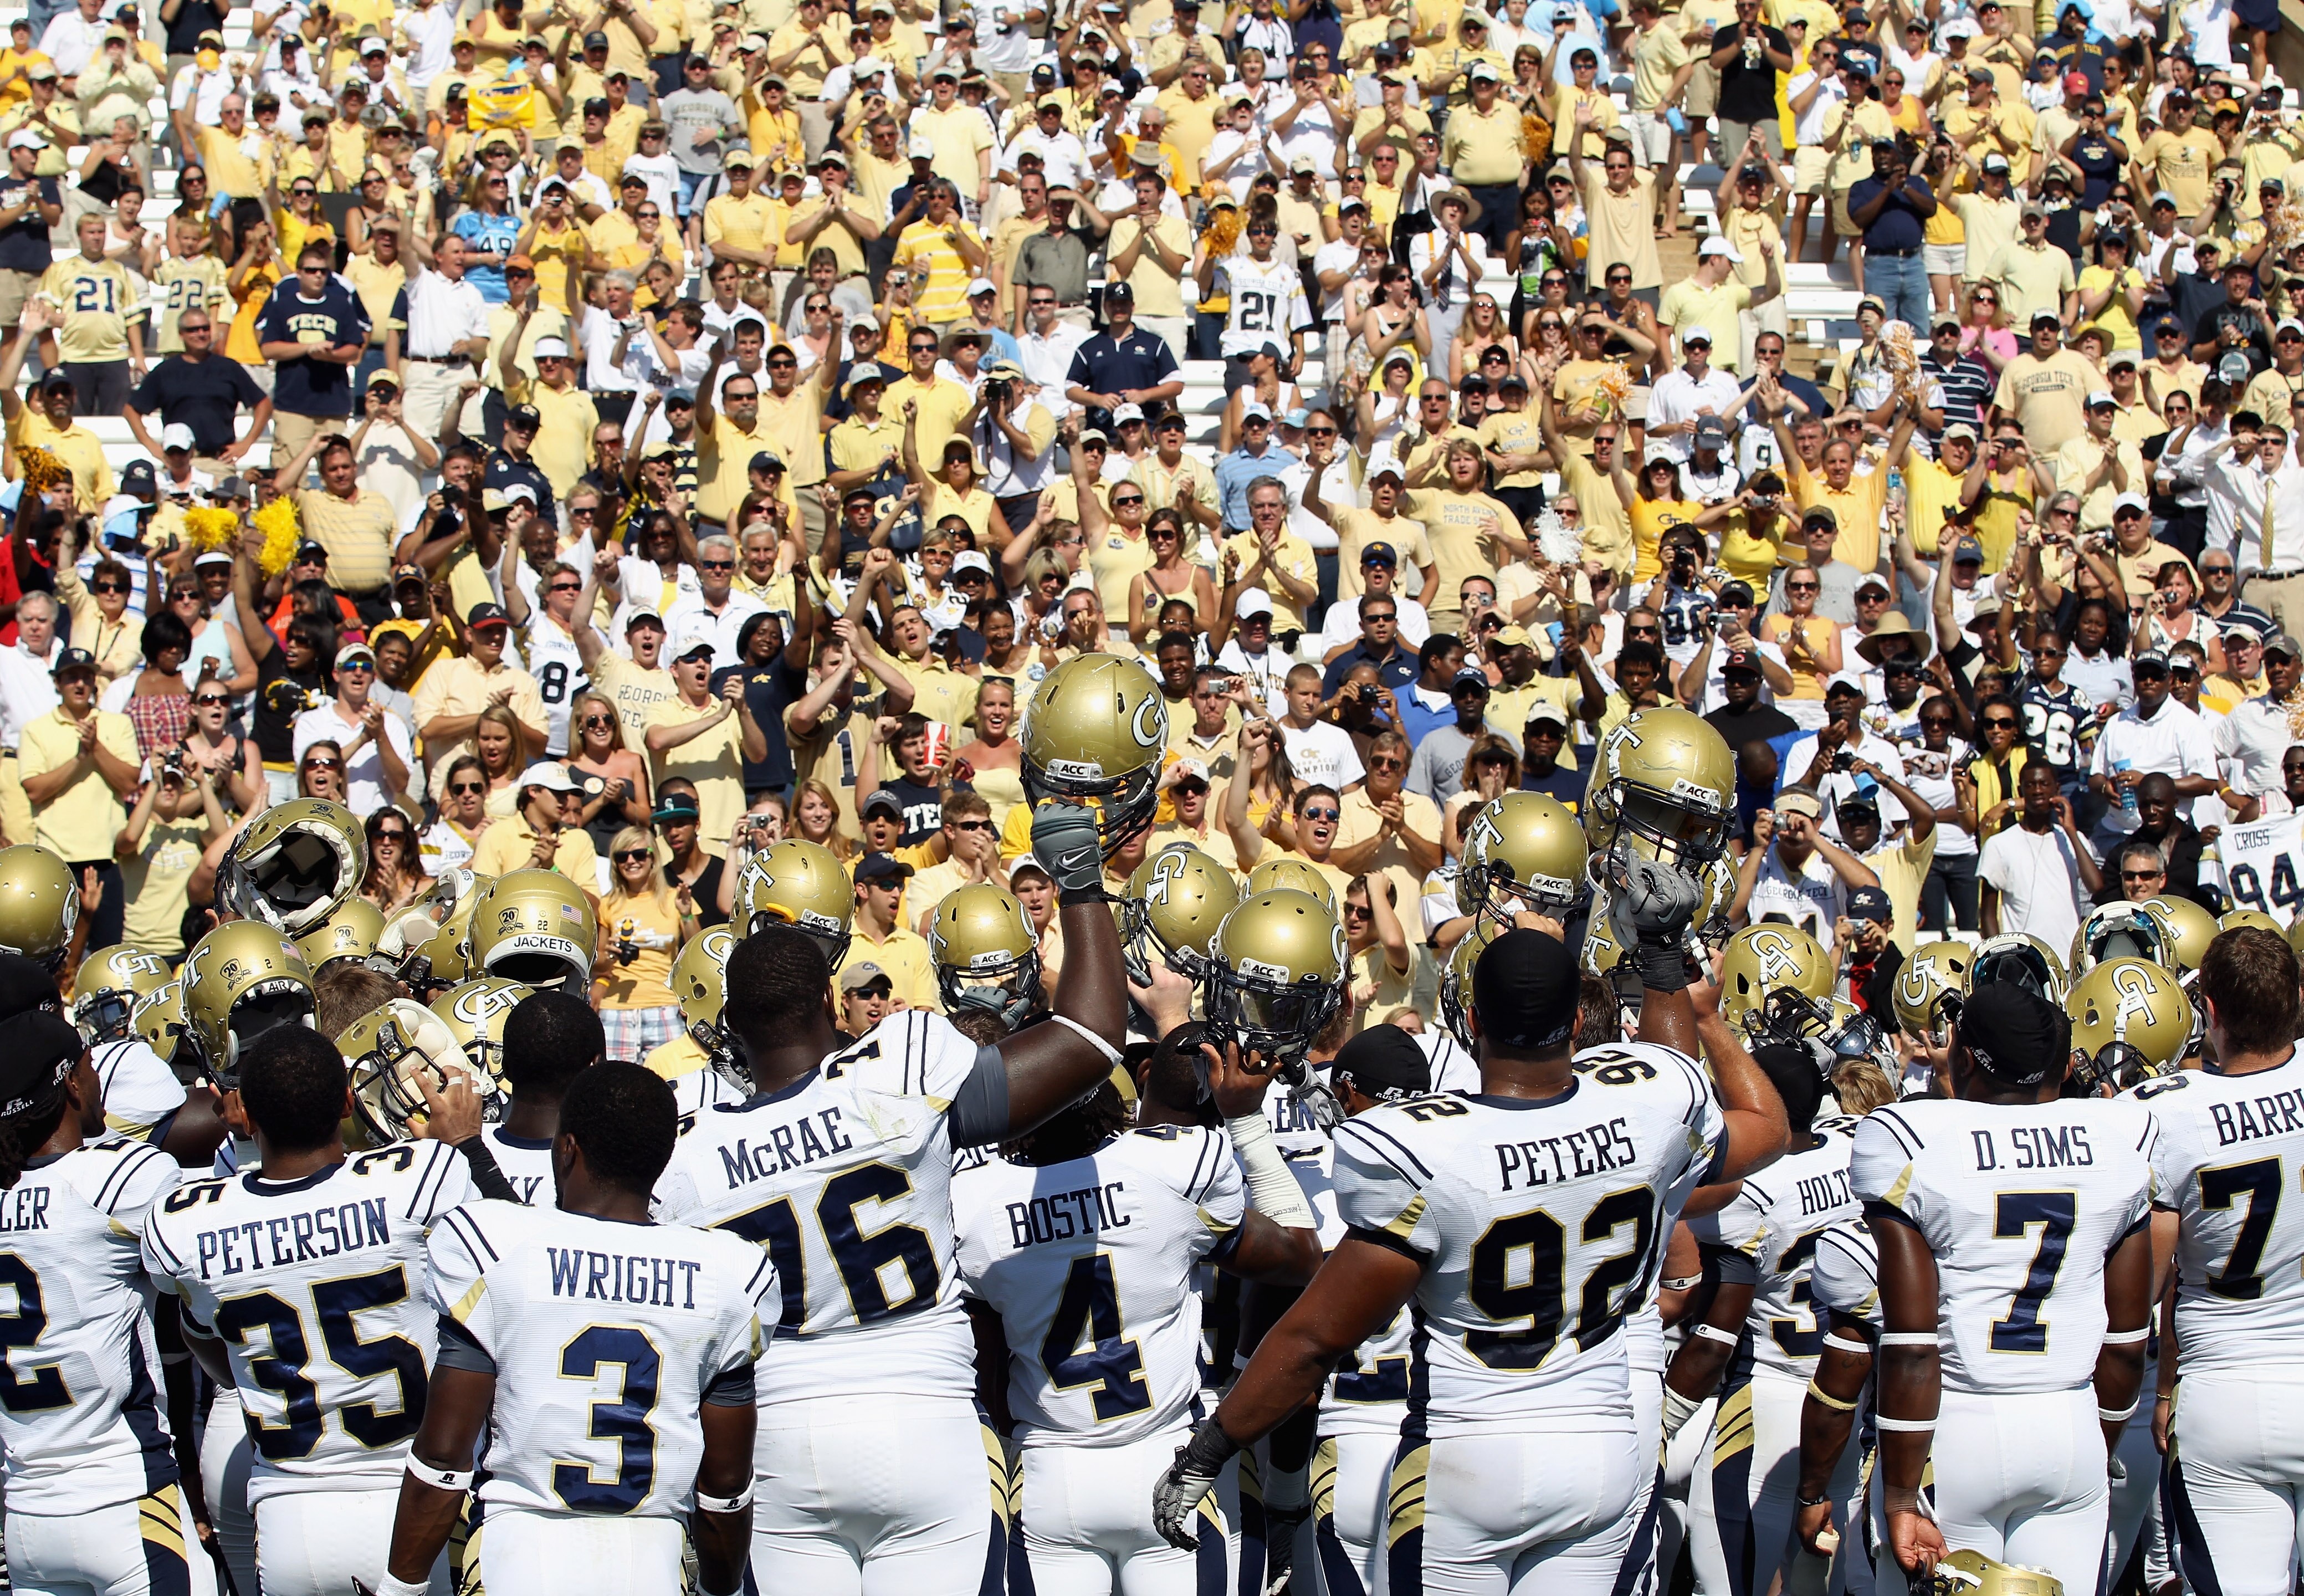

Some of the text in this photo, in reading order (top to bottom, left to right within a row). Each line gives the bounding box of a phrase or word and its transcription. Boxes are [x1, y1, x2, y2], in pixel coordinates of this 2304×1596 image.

[74, 277, 114, 314] 21
[168, 279, 203, 309] 22
[1240, 291, 1276, 331] 21
[286, 313, 338, 336] TECH
[2019, 372, 2051, 390] GEORGIA
[2054, 371, 2074, 386] TECH
[1757, 445, 1771, 466] 9
[1443, 505, 1470, 514] NORTH
[1443, 515, 1471, 525] TRADE
[1658, 513, 1682, 526] GT
[621, 707, 641, 728] TE
[834, 728, 857, 786] 1
[1061, 764, 1086, 775] ACC
[1296, 763, 1339, 776] AMPION
[1686, 787, 1708, 799] ACC
[904, 803, 942, 834] TE
[2234, 831, 2269, 852] CROSS
[1542, 879, 1565, 889] ACC
[2231, 852, 2304, 918] 94
[501, 914, 515, 924] 20
[537, 920, 547, 931] 22
[812, 916, 830, 927] ACC
[339, 928, 351, 938] 20
[513, 935, 573, 953] JACKETS
[109, 949, 161, 976] GT
[264, 958, 273, 969] 2
[1188, 953, 1204, 964] ACC
[1749, 929, 1803, 980] GT
[223, 963, 238, 978] 20
[1251, 965, 1276, 977] ACC
[1970, 1046, 1995, 1073] RUSSELL
[1, 1099, 34, 1117] RUSSELL
[1495, 1117, 1637, 1192] PETERS
[1971, 1126, 2093, 1171] D. SIMS
[1796, 1166, 1852, 1216] HOLT
[1004, 1181, 1131, 1250] BOSTIC
[2198, 1154, 2283, 1302] 7
[197, 1196, 390, 1281] PETERSON
[708, 1160, 943, 1334] 76
[546, 1246, 701, 1309] WRIGHT
[1462, 1183, 1657, 1373] 92
[1986, 1189, 2079, 1356] 7
[1038, 1249, 1154, 1423] 4
[213, 1261, 432, 1462] 35
[549, 1322, 664, 1515] 3
